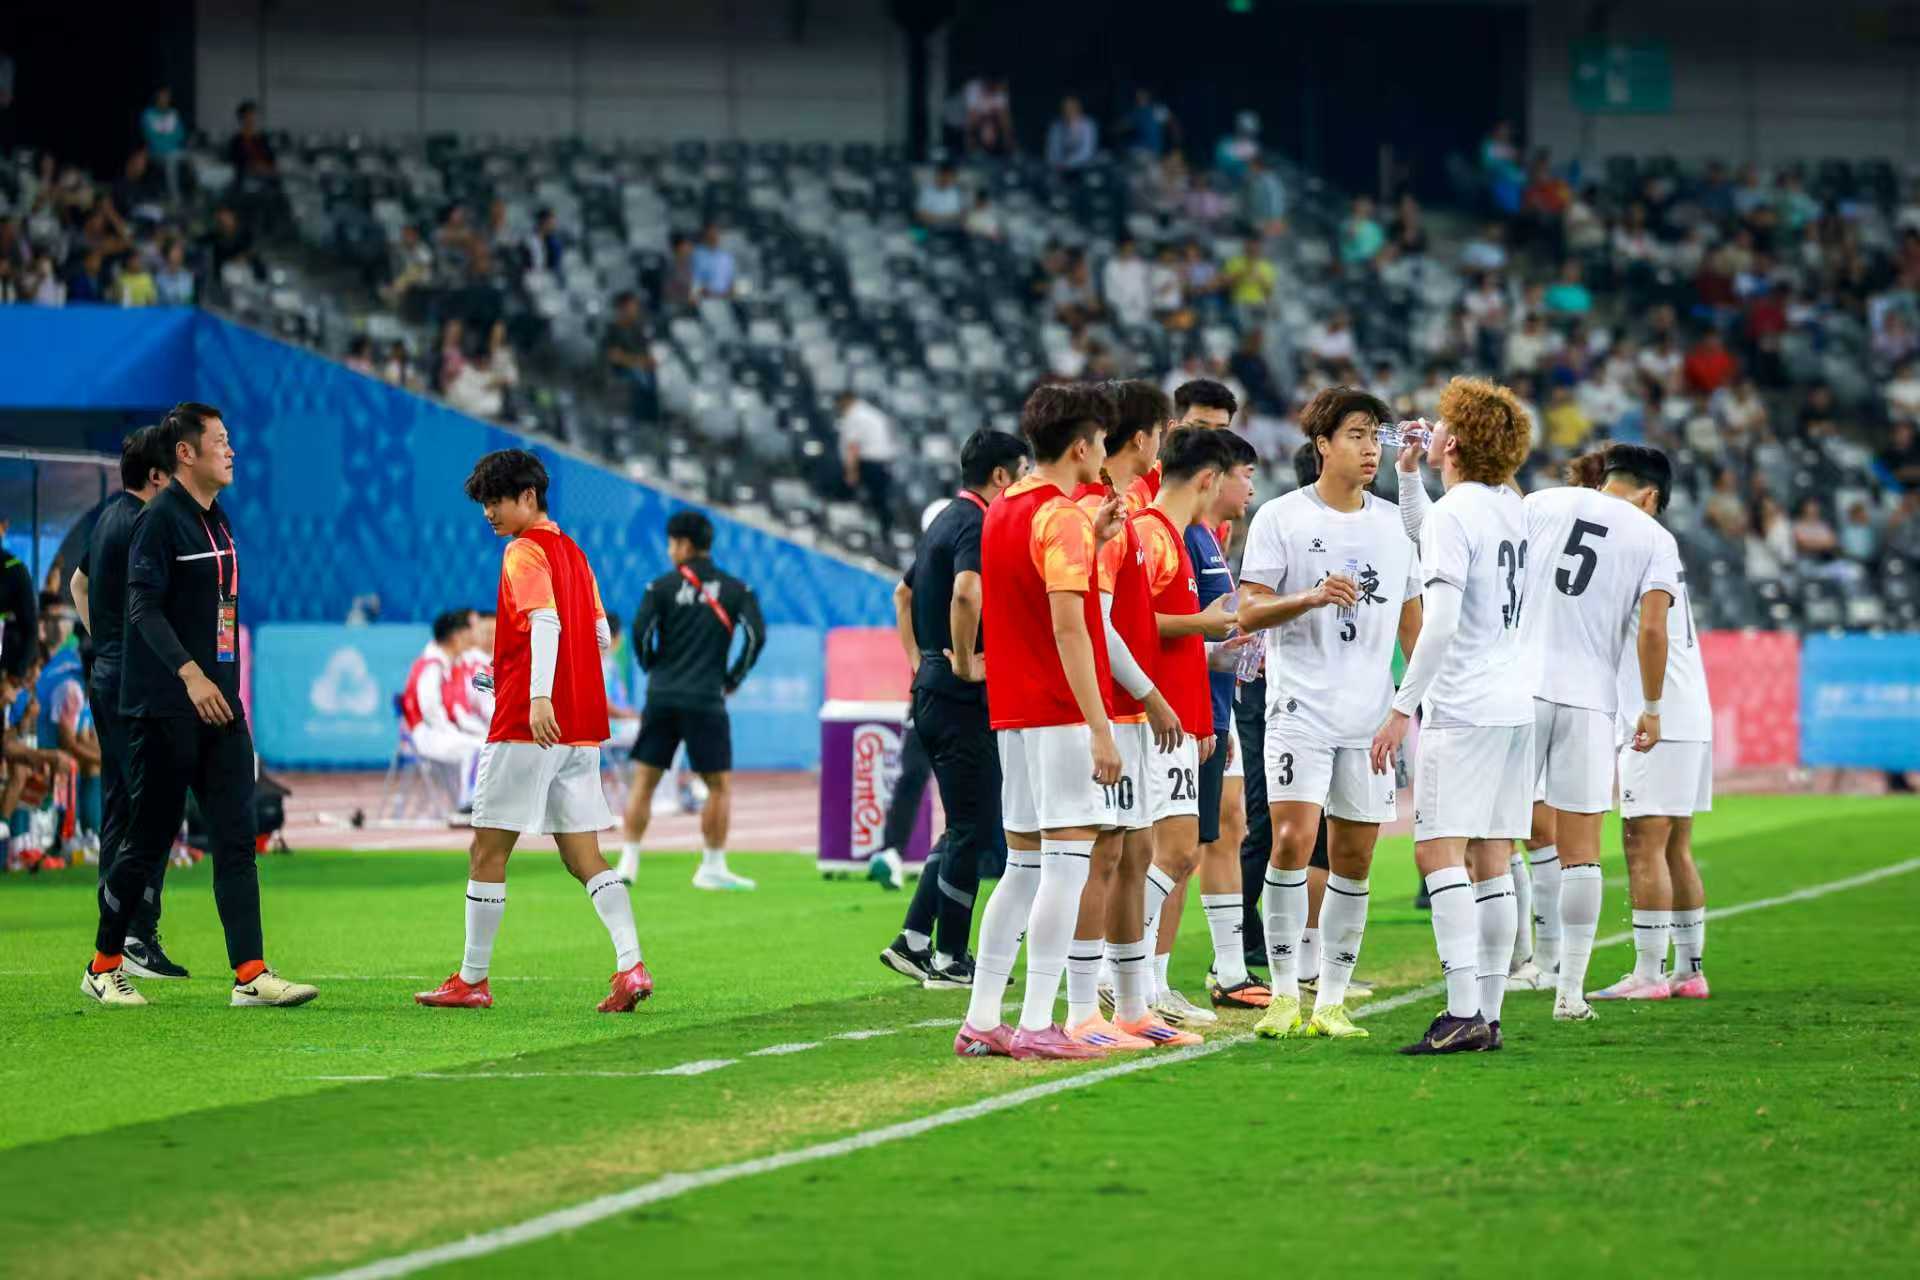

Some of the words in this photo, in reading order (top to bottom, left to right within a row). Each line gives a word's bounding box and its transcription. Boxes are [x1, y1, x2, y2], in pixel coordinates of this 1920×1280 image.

[1555, 518, 1609, 597] 5
[1168, 767, 1198, 801] 28
[1279, 752, 1294, 786] 3
